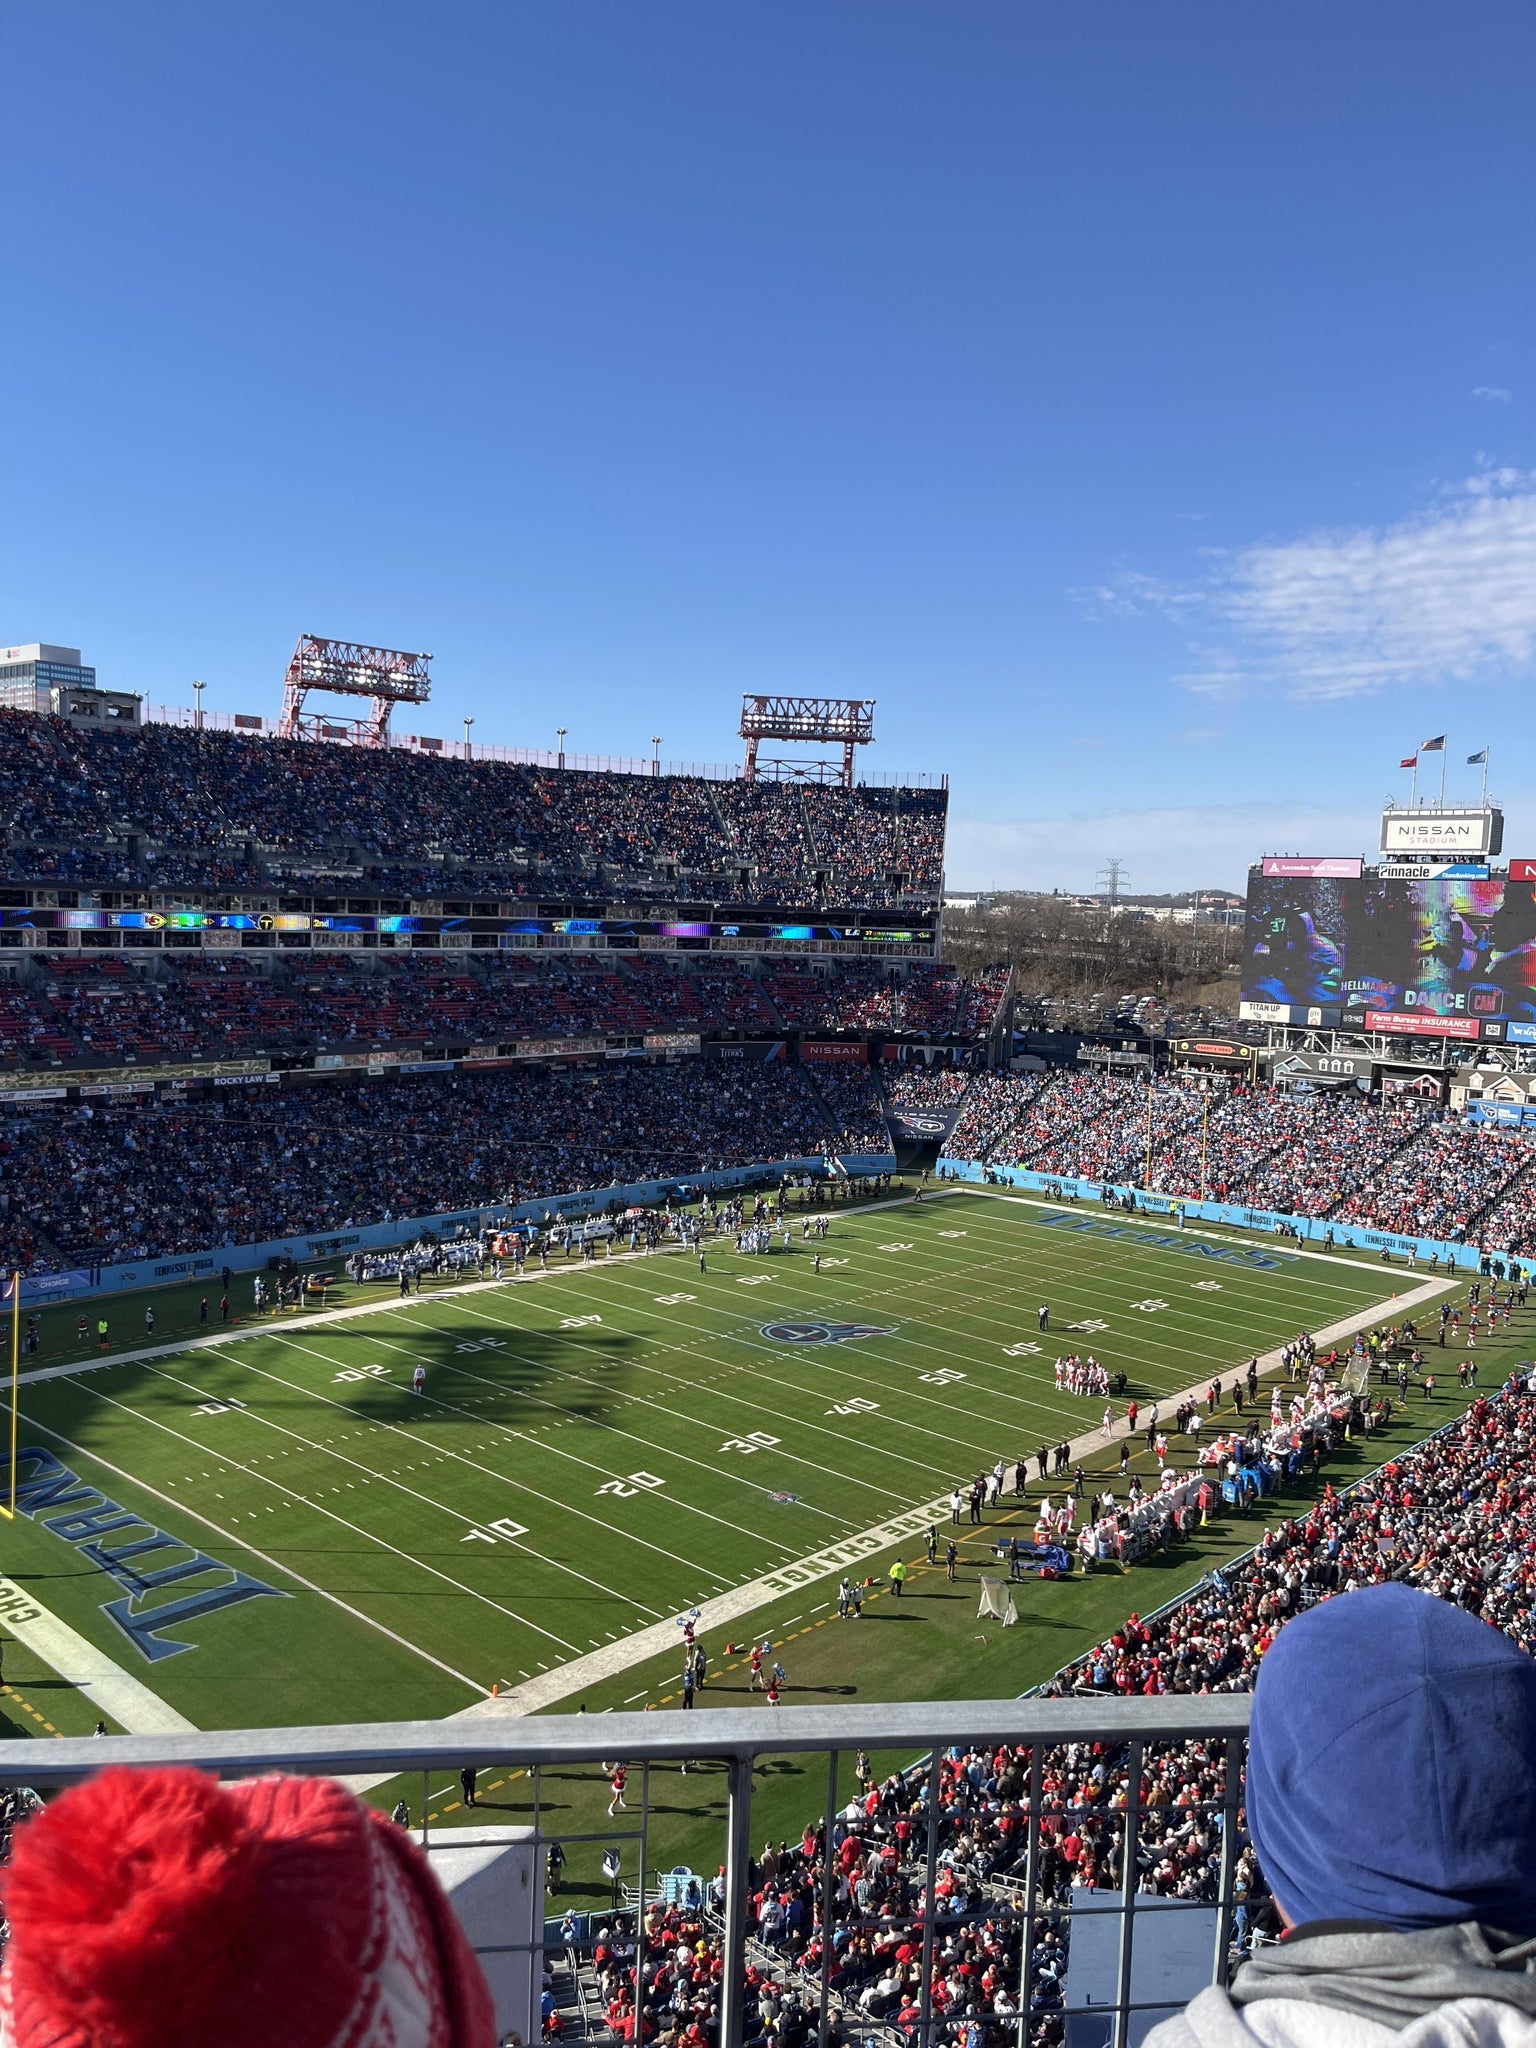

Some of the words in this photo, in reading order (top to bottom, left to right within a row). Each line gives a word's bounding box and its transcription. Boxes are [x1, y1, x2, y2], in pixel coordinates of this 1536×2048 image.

[1399, 826, 1470, 835] NISSAN
[1380, 865, 1430, 878] Pinnacle
[1405, 990, 1465, 1010] DANCE
[1249, 1003, 1270, 1012] TITAN
[1271, 1005, 1281, 1013] UP
[1371, 1013, 1391, 1022] Farm
[1392, 1015, 1420, 1025] Bureau
[1421, 1018, 1472, 1029] INSURANCE
[720, 1048, 744, 1058] TITANS
[810, 1046, 860, 1055] NISSAN
[172, 1080, 195, 1089] FedEx
[214, 1077, 244, 1086] ROCKY
[245, 1075, 264, 1083] LAW
[894, 1111, 948, 1119] NISSAN
[1243, 1213, 1272, 1226] TENNESSEE
[1365, 1234, 1396, 1248] TENNESSEE
[40, 1278, 71, 1289] CHANGE
[1002, 1341, 1043, 1357] 40
[917, 1367, 968, 1386] 50
[833, 1396, 881, 1416] 40
[722, 1431, 782, 1454] 30
[600, 1471, 667, 1497] 20
[469, 1517, 530, 1544] 10
[760, 1536, 884, 1593] CHANGE
